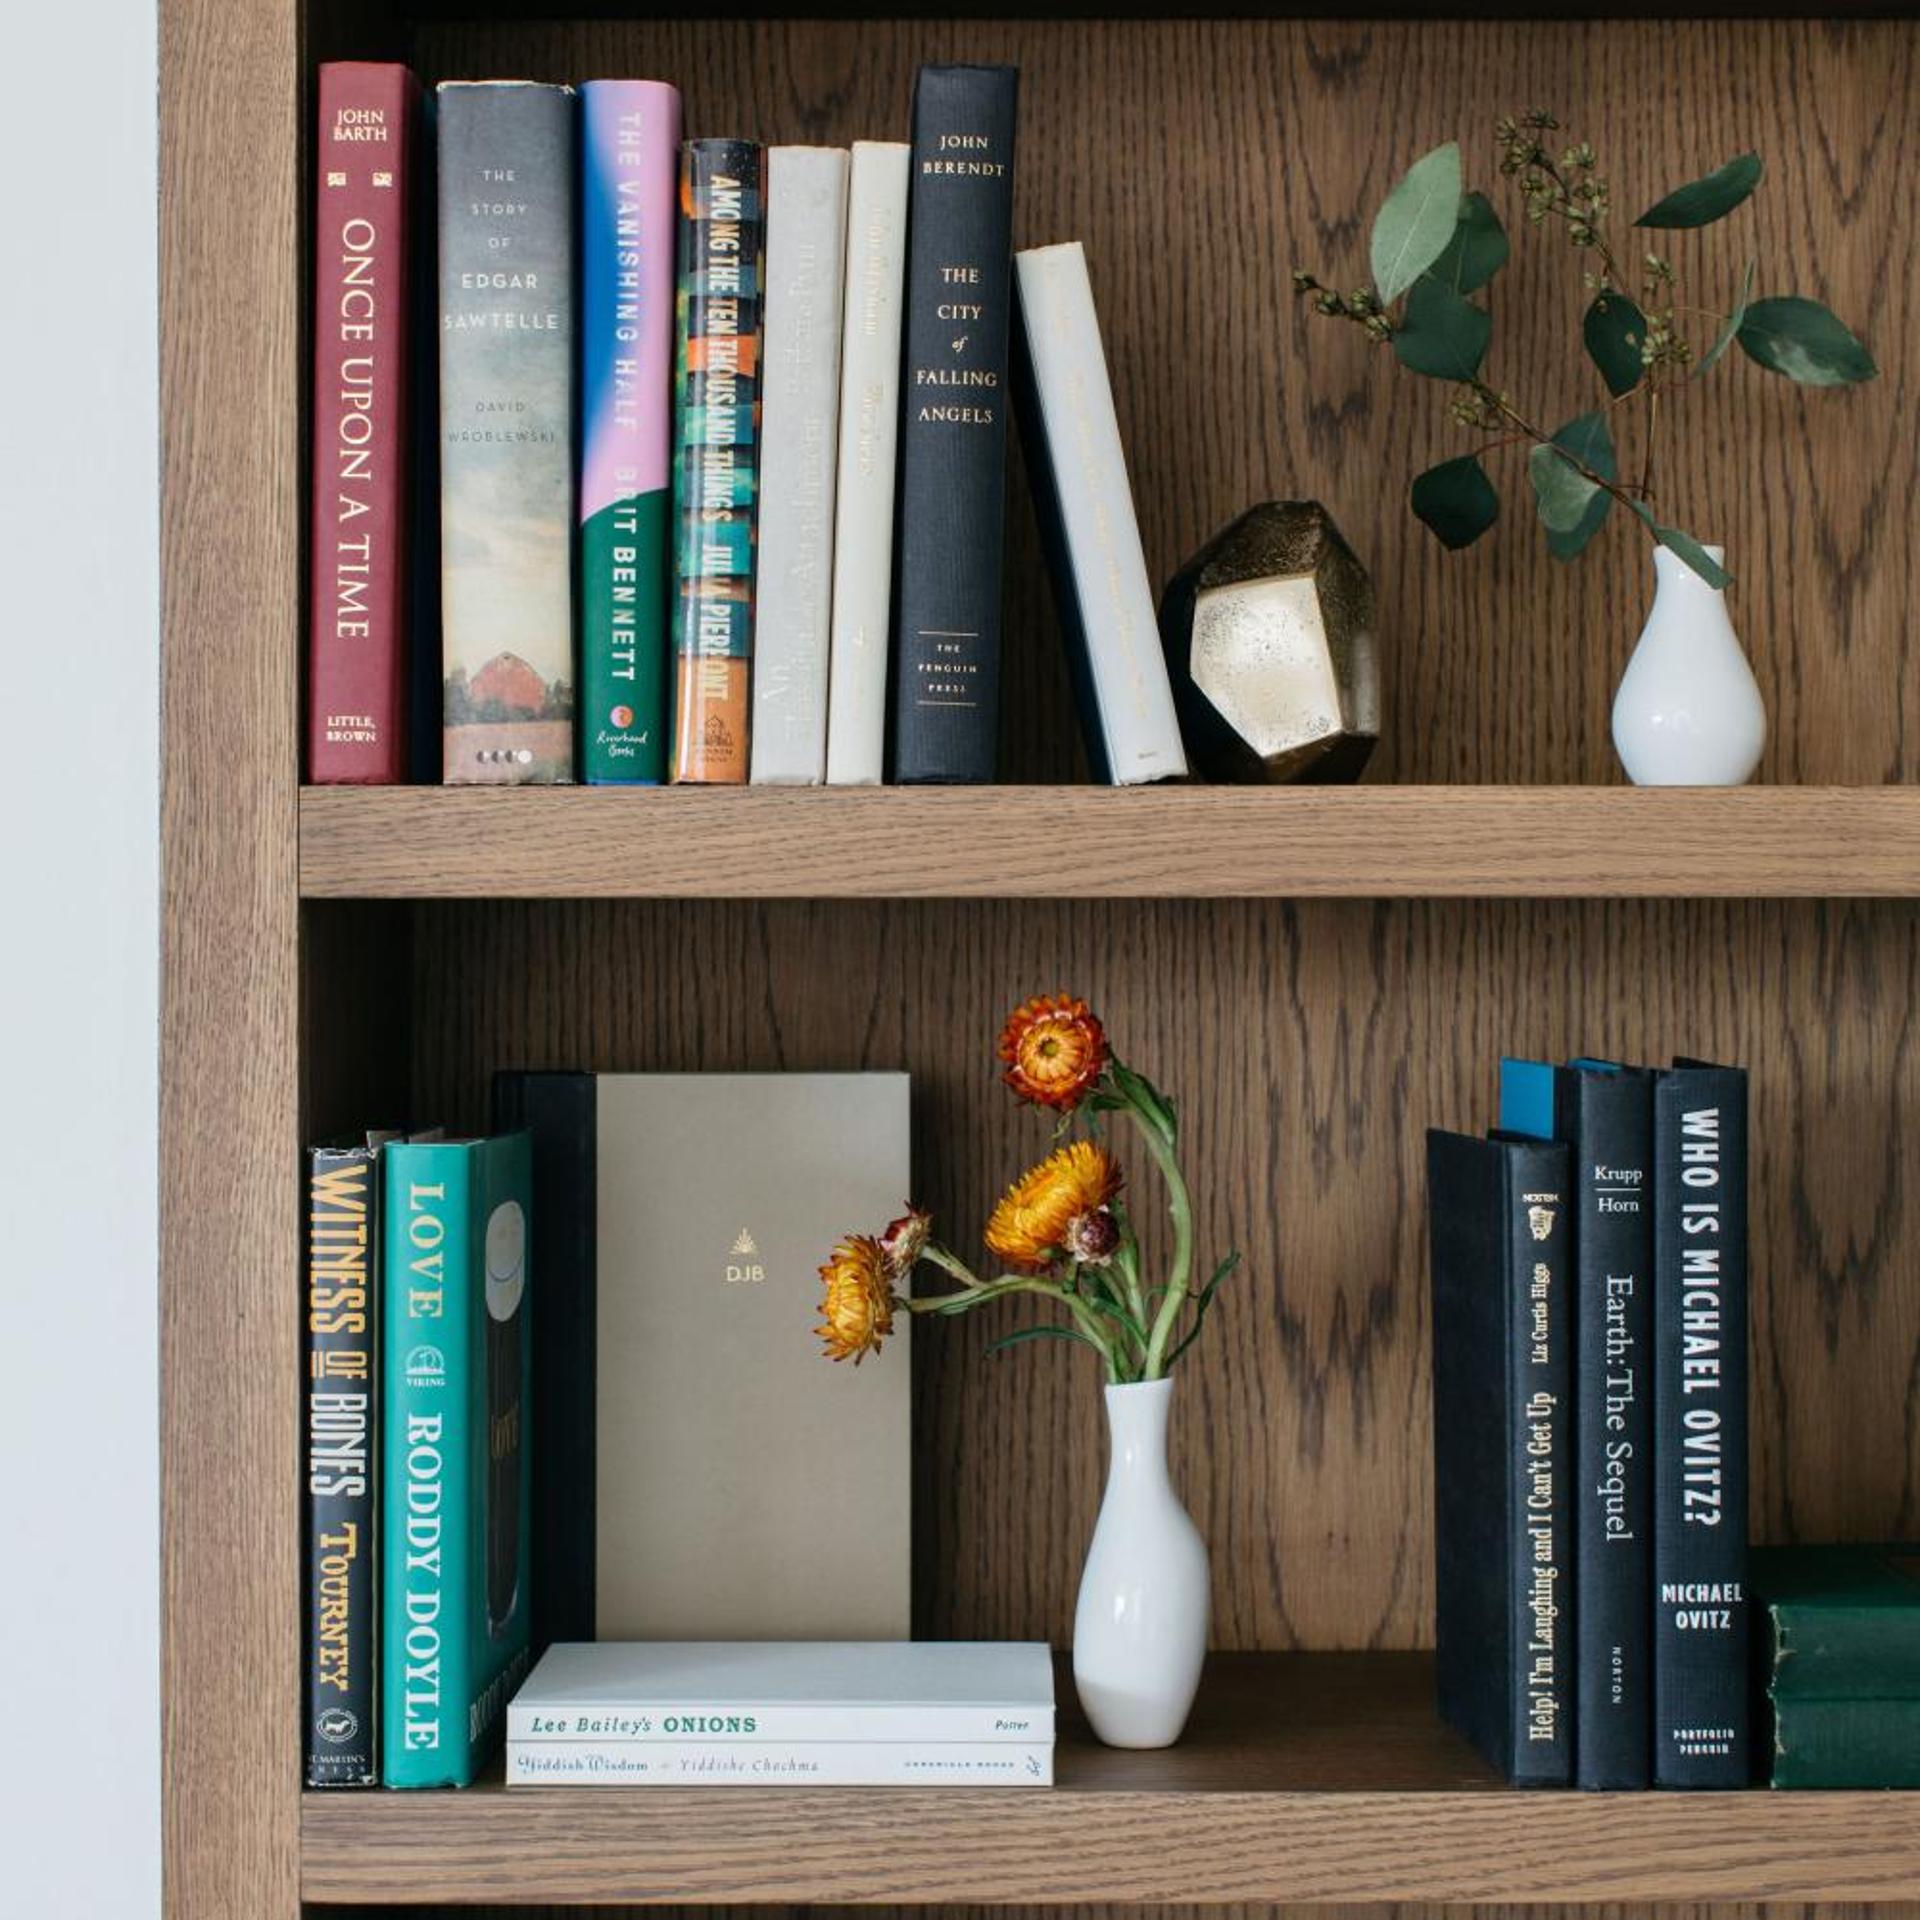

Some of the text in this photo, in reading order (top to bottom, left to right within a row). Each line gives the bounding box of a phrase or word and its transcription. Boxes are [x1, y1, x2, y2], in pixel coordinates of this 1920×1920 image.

[337, 109, 384, 125] JOHN
[334, 127, 387, 141] BARTH
[939, 135, 988, 151] JOHN
[483, 170, 516, 182] THE
[922, 162, 1005, 178] BERENDT
[471, 203, 528, 216] STORY
[488, 237, 511, 249] OF
[614, 112, 643, 431] THE VANISHING HALF
[941, 267, 980, 284] THE
[461, 273, 539, 290] EDGAR
[937, 304, 982, 321] CITY
[444, 313, 559, 330] SAWTELLE
[702, 175, 742, 522] AMONG THE TEN THOUSAND THINGS
[951, 335, 969, 353] of
[916, 370, 998, 388] FALLING
[475, 400, 525, 413] DAVID
[918, 406, 993, 424] ANGELS
[337, 218, 376, 639] ONCE UPON A TIME
[449, 430, 556, 443] WROBLEWSKI
[611, 466, 638, 681] BRIT BENNETT
[937, 644, 961, 653] THE
[918, 663, 977, 673] PENGUIN
[327, 715, 376, 730] LITTLE,
[326, 731, 376, 743] BROWN
[1594, 1165, 1643, 1185] Krupp
[1598, 1197, 1640, 1213] Horn
[408, 1181, 446, 1319] LOVE
[726, 1265, 765, 1282] DJB
[1531, 1262, 1551, 1364] Liz Curtis Higgs
[1681, 1106, 1722, 1527] WHO IS MICHAEL OVITZ?
[310, 1164, 368, 1497] WITNESS OF BONES
[406, 1377, 446, 1388] VIKING
[1596, 1441, 1634, 1543] Sequel
[1526, 1391, 1559, 1741] Help! I'm Laughing and I Can't Get Up
[404, 1412, 443, 1750] RODDY DOYLE
[1661, 1583, 1743, 1604] MICHAEL
[1675, 1609, 1731, 1630] OVITZ
[1612, 1646, 1623, 1704] NORTON
[531, 1716, 757, 1736] Lee Bailey's ONIONS
[995, 1719, 1029, 1730] Potter
[1673, 1729, 1735, 1741] PORTFOLIO
[517, 1753, 649, 1774] Yiddish Wisdom
[679, 1756, 746, 1772] Yiddishe
